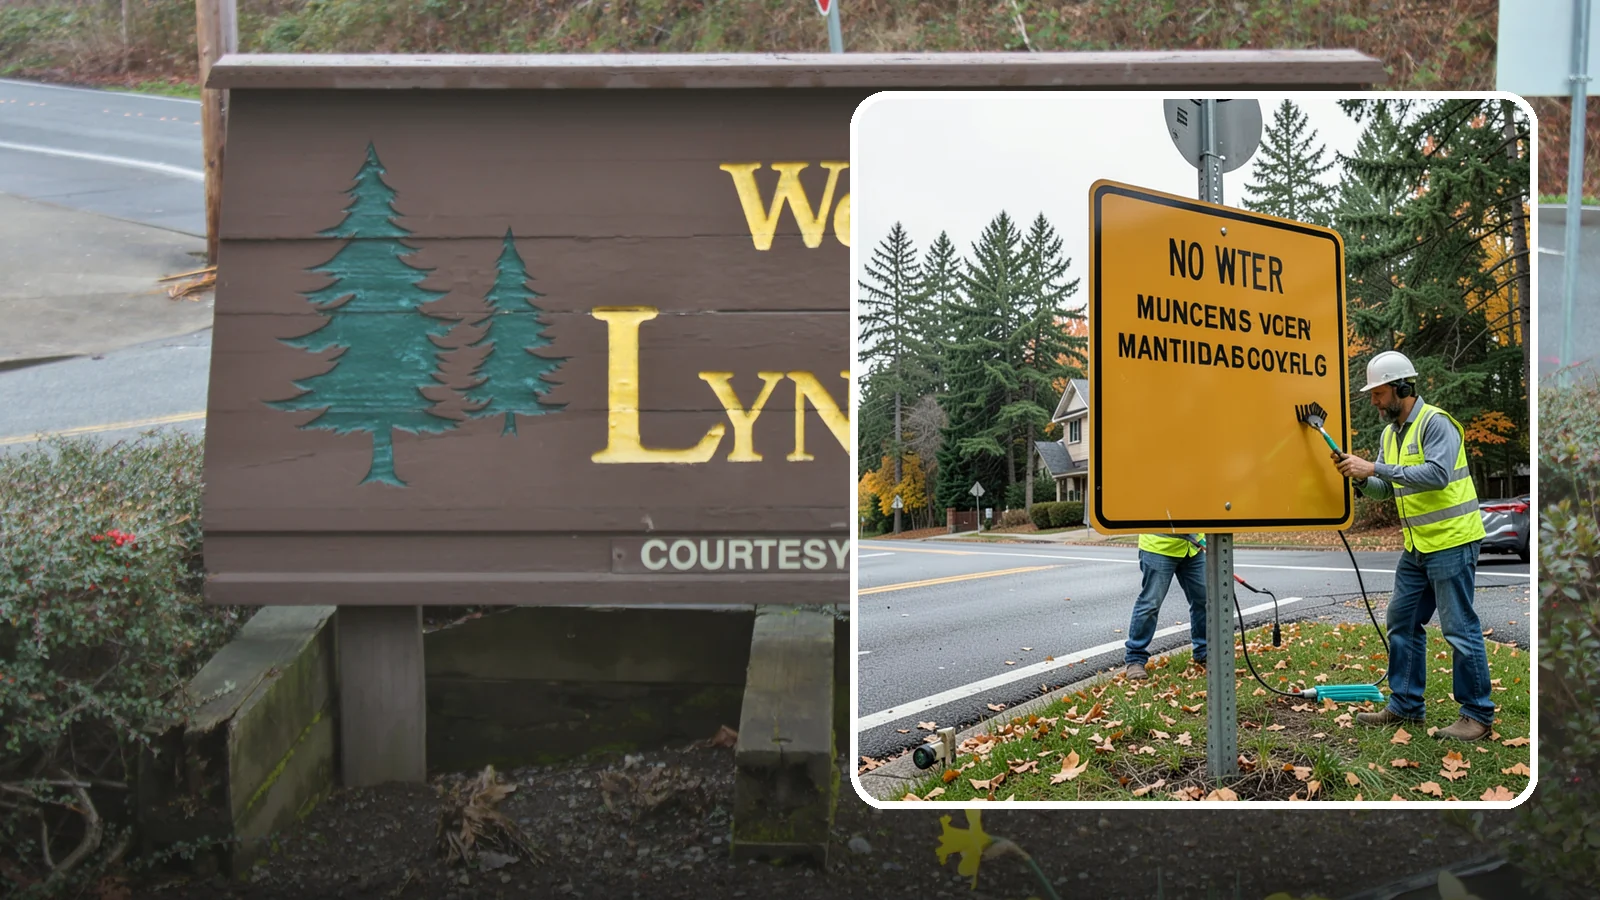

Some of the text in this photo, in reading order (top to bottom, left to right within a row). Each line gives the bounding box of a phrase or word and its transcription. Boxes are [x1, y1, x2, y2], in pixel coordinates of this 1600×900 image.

[1169, 238, 1284, 294] NO WTER
[1137, 293, 1252, 333] MUNCENS
[641, 539, 850, 571] COURTESY
